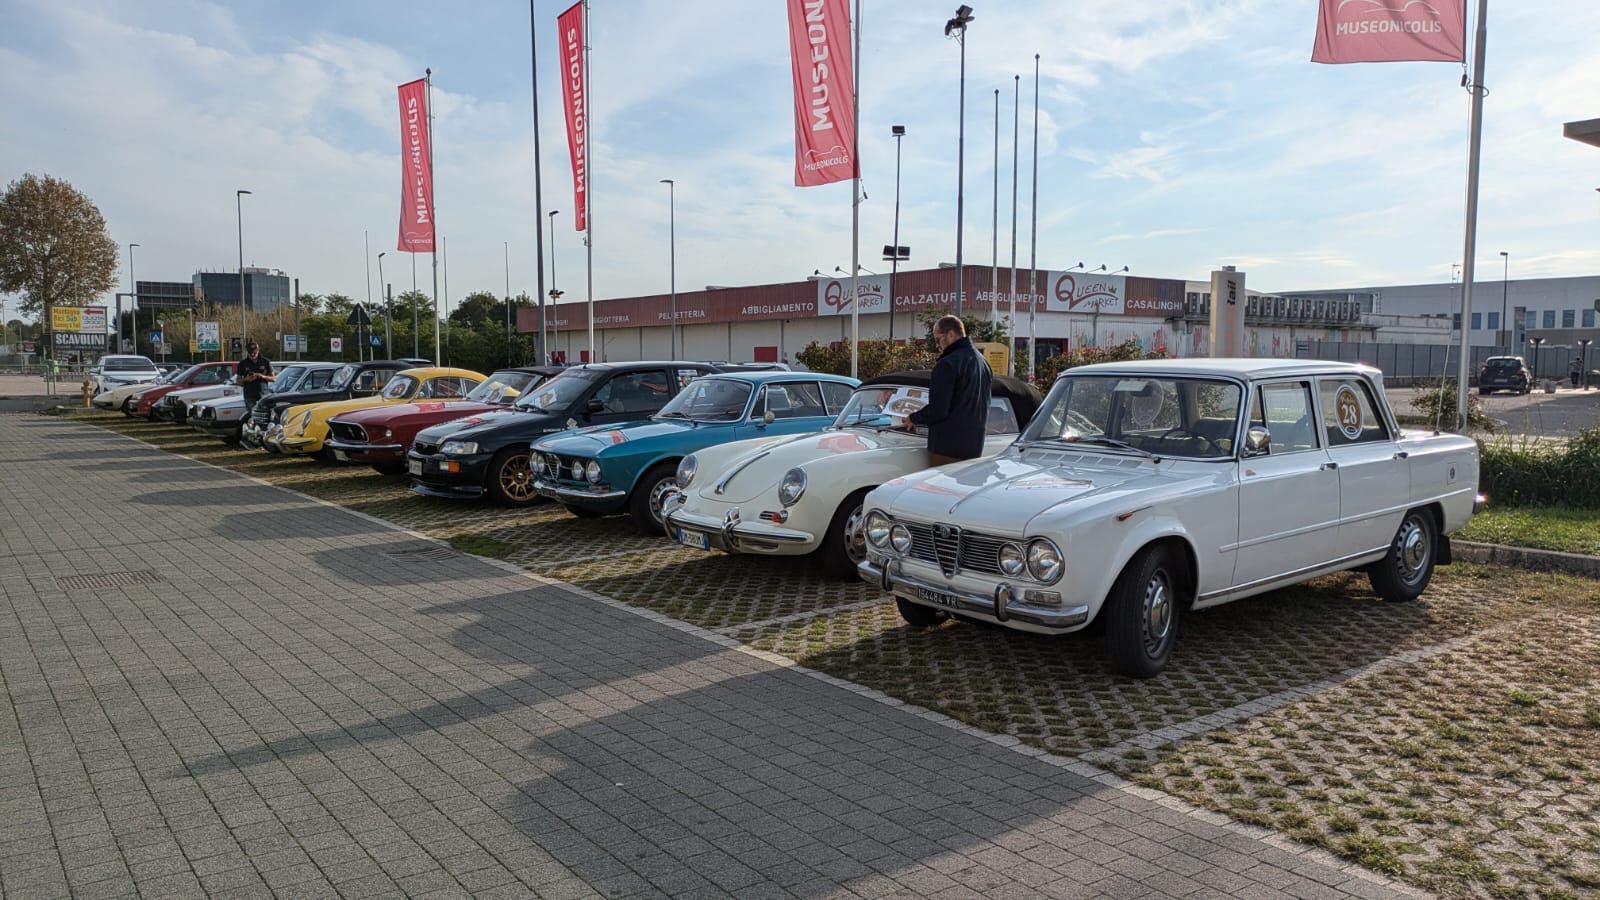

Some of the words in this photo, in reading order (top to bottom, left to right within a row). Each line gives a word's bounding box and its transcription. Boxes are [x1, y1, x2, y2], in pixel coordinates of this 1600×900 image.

[1336, 20, 1442, 36] MUSEONICOLIS
[567, 28, 585, 193] MUSEONICOLIS
[895, 291, 967, 306] CALZATURE
[1126, 299, 1183, 311] CASALINGHI
[741, 302, 814, 315] ABBIGLIAMENTO
[55, 333, 105, 345] SCAVOLINI
[1341, 404, 1357, 425] 28
